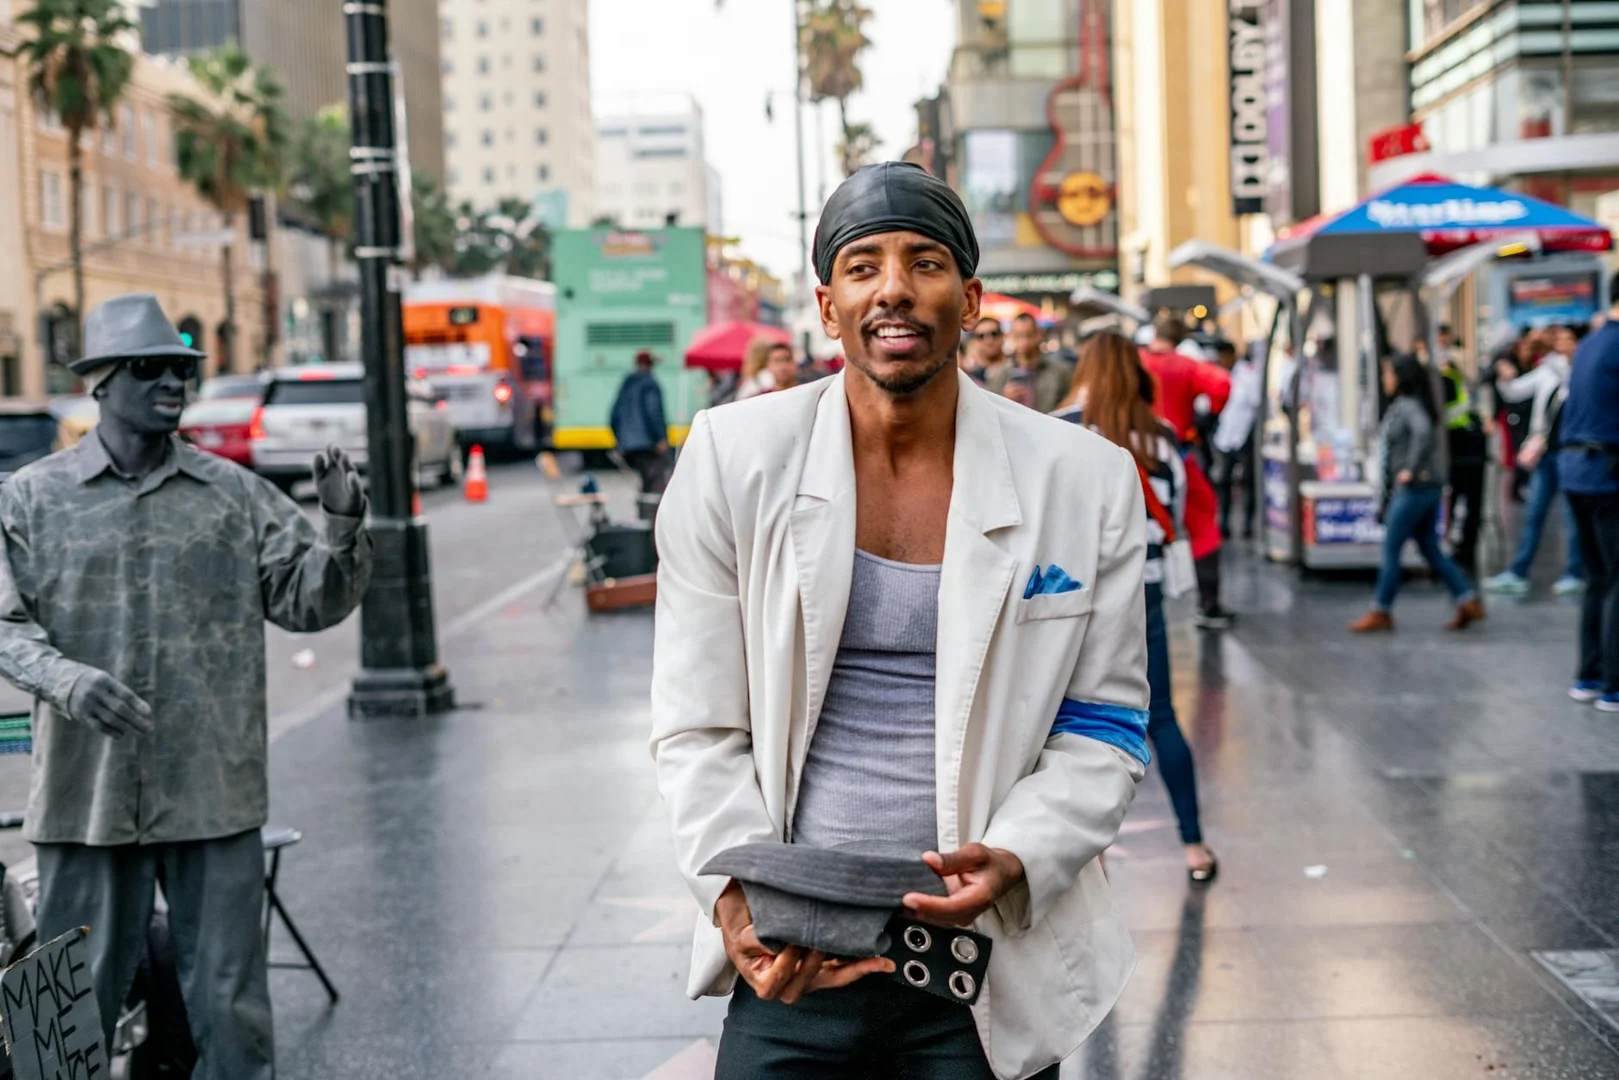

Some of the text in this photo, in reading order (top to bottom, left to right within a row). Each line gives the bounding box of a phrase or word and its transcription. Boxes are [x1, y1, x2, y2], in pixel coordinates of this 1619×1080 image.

[1232, 16, 1267, 143] DOLBY
[2, 936, 92, 1043] MAKE
[33, 1003, 81, 1080] ME
